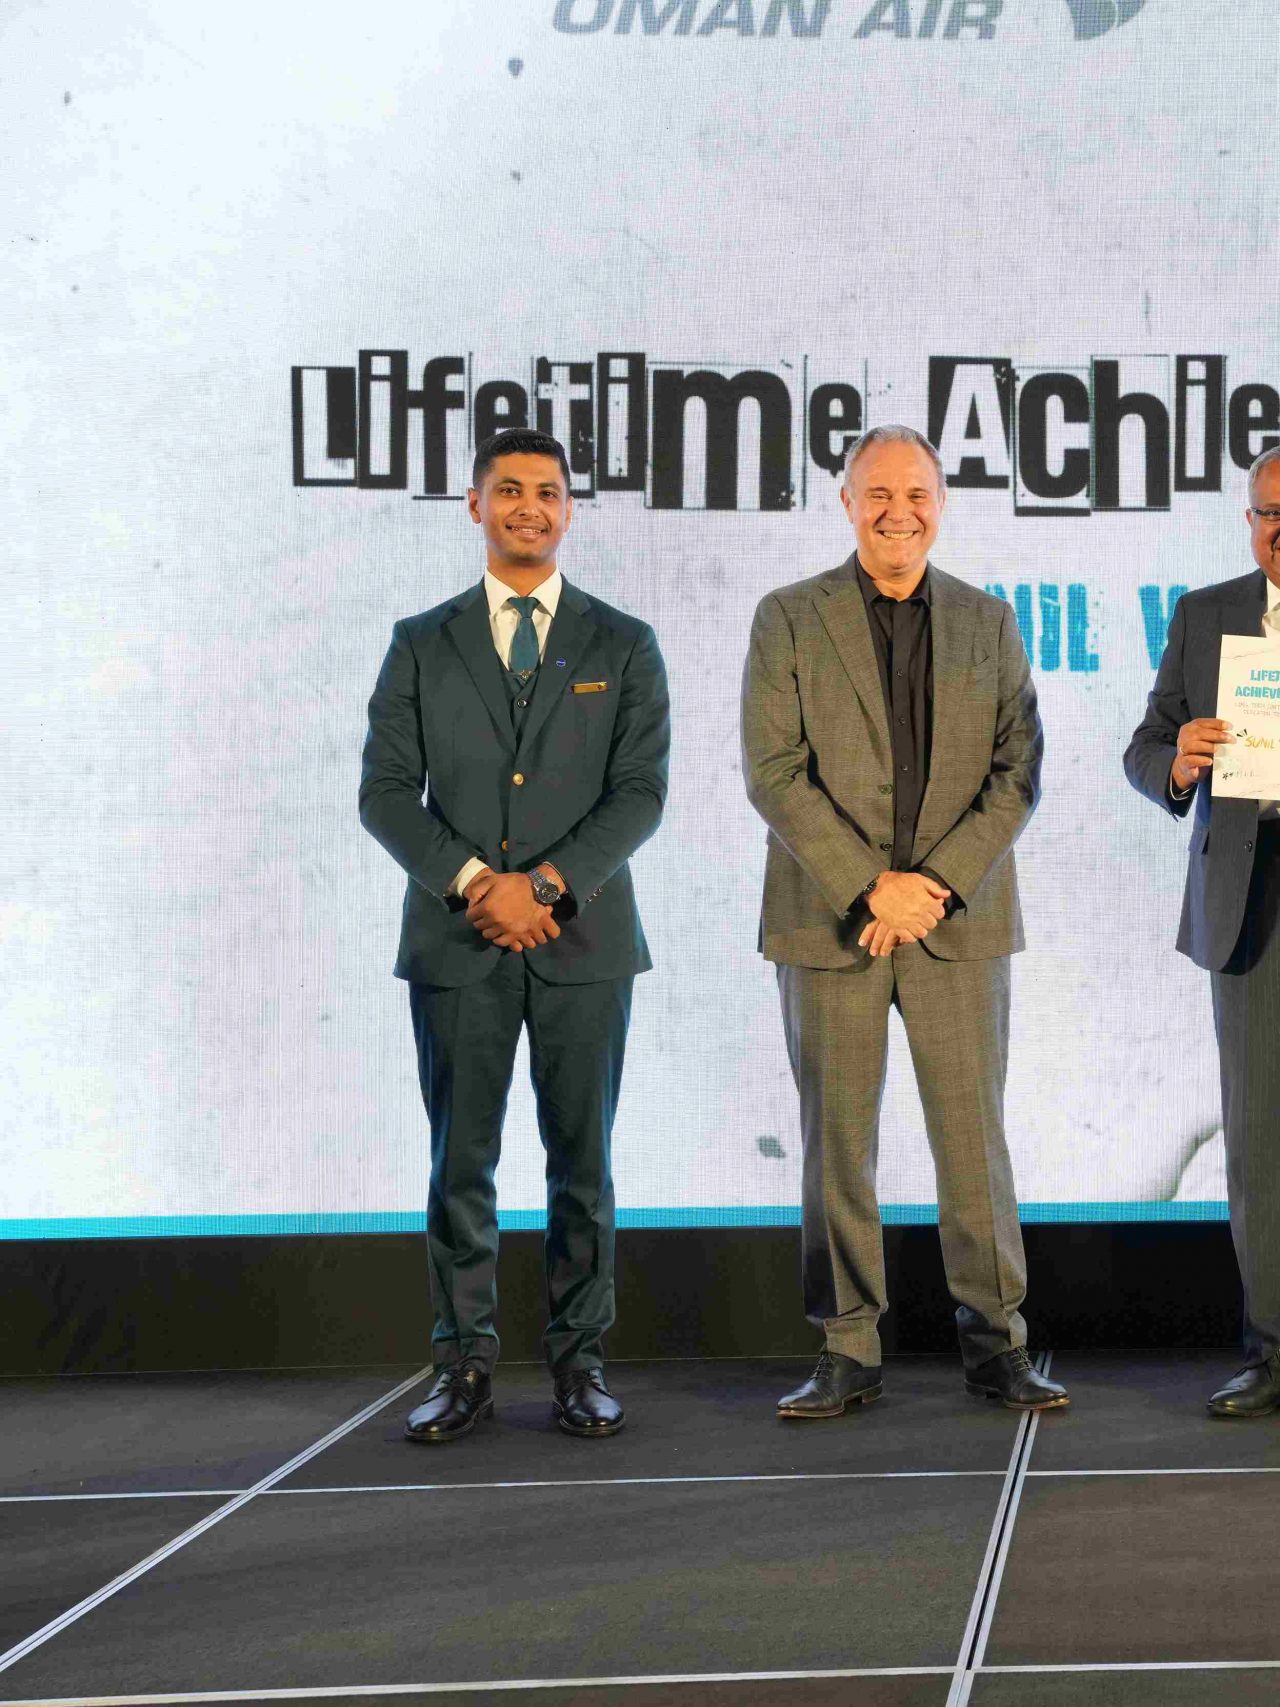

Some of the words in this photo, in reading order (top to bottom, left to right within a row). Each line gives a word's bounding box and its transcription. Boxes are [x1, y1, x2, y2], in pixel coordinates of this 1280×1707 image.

[551, 0, 833, 38] OMAN
[852, 0, 1003, 40] AIR
[1244, 736, 1276, 749] SUNIL
